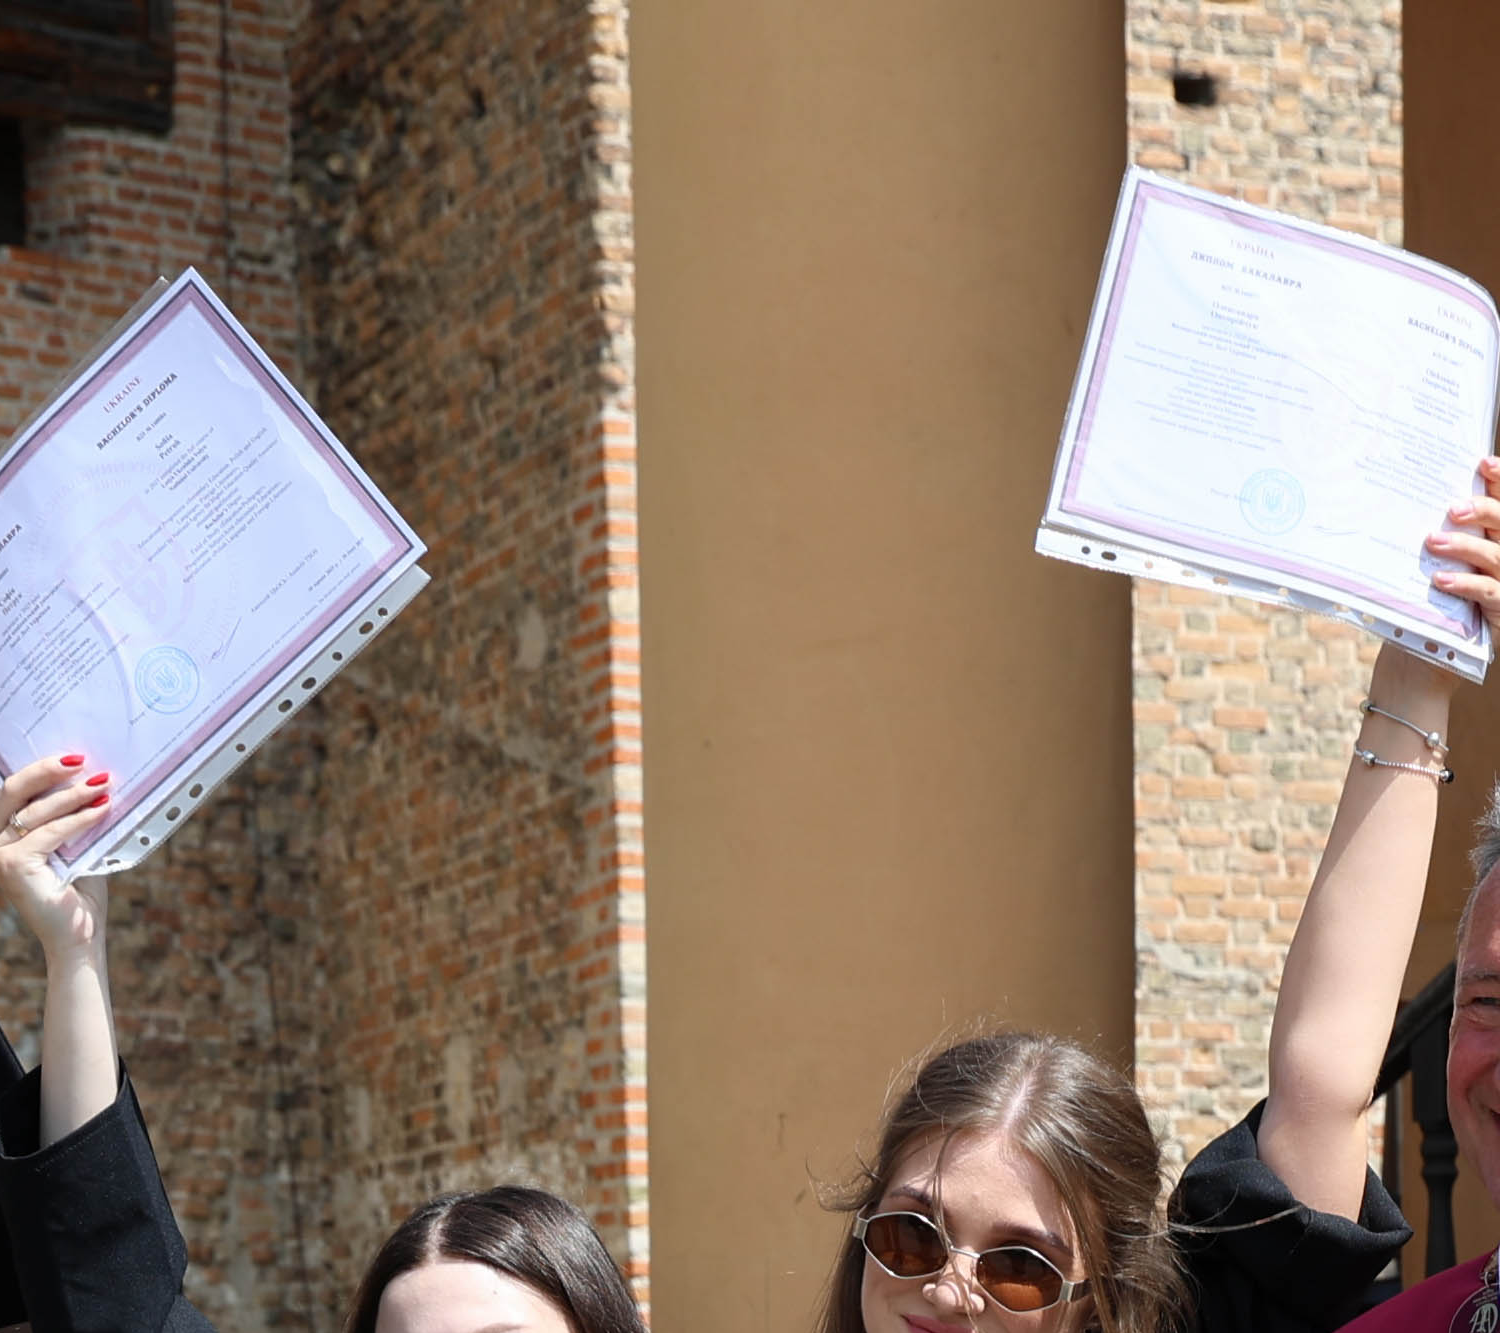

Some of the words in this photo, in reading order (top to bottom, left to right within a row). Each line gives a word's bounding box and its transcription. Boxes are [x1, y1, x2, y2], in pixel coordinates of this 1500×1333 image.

[97, 405, 143, 450] BACHELOR'S
[143, 373, 177, 406] DIPLOMA
[103, 377, 140, 413] UKRAINE
